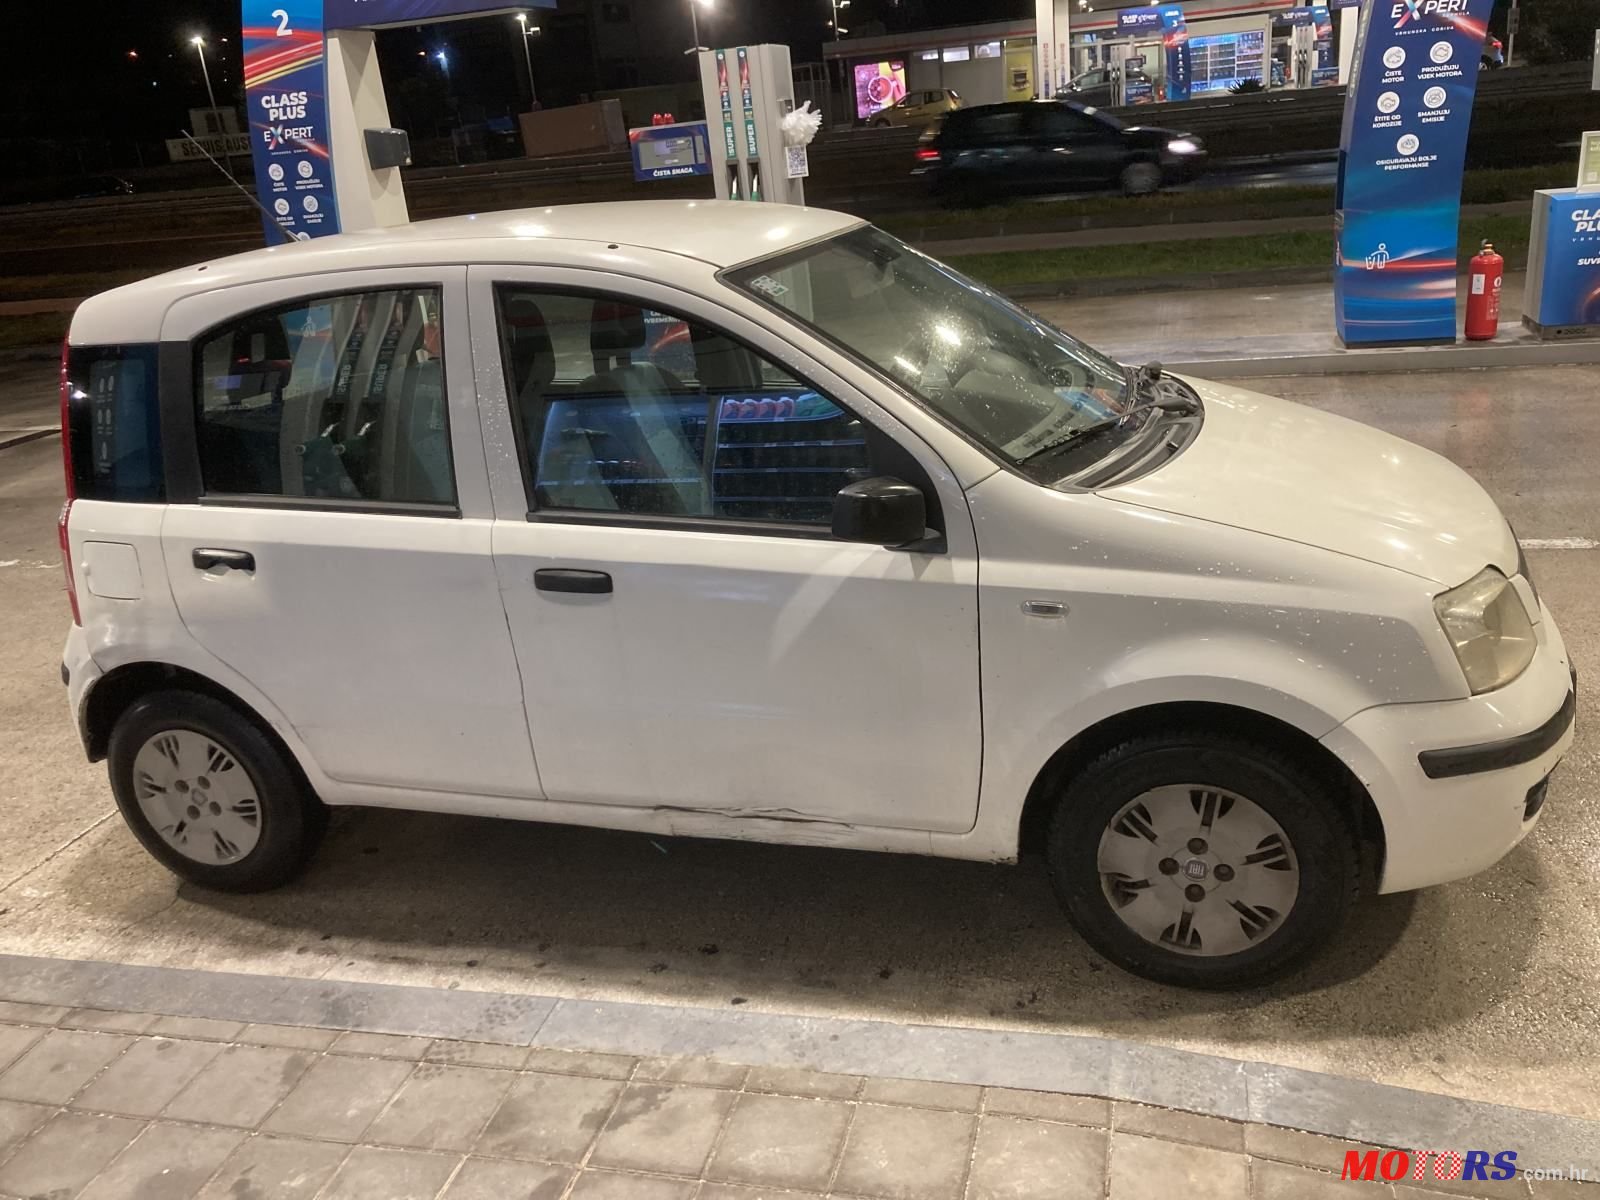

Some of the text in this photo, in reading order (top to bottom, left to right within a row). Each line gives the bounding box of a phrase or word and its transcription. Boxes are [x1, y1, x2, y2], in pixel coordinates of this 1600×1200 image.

[271, 9, 293, 37] 2
[261, 92, 308, 108] CLASS
[269, 106, 306, 121] PLUS
[264, 124, 313, 150] EXPERT
[726, 126, 735, 154] SUPER
[747, 124, 756, 152] SUPER
